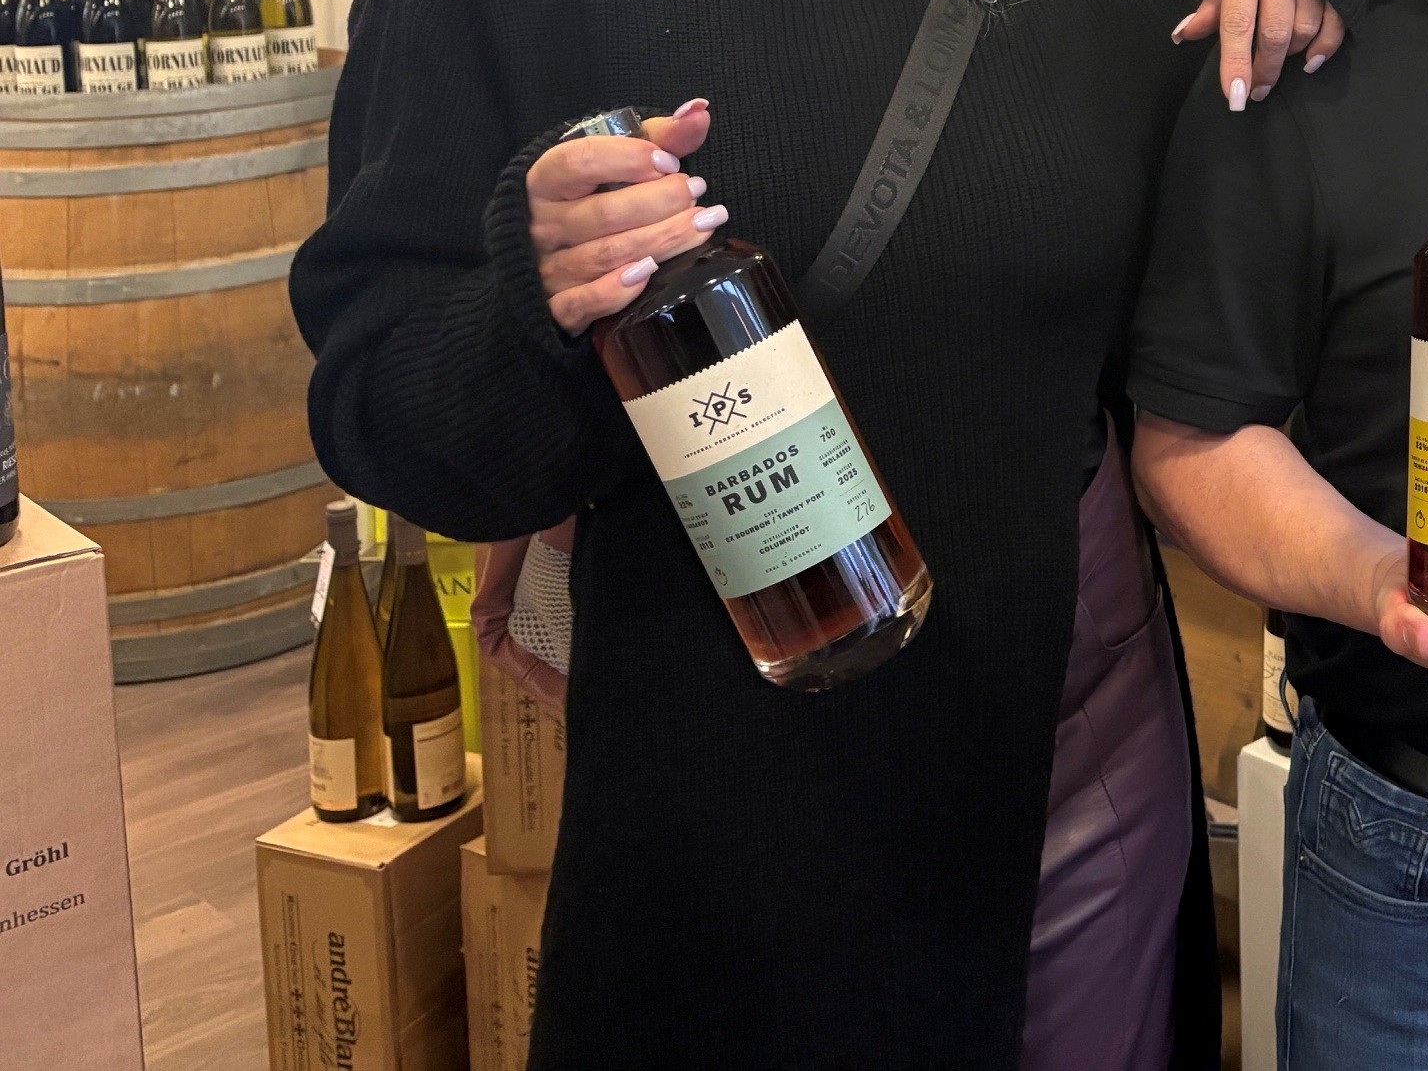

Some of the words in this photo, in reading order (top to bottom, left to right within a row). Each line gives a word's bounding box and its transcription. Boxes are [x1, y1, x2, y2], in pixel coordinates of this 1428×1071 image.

[81, 53, 134, 72] RNIAUD
[715, 428, 748, 446] PERSONAL
[751, 408, 785, 428] SELECTION
[819, 428, 836, 443] 700
[705, 444, 799, 497] BARBADOS
[822, 445, 852, 467] MOLASSES
[721, 464, 800, 516] RUM
[837, 468, 858, 485] 2025
[724, 535, 735, 543] EX
[735, 520, 771, 540] BOURBON
[777, 503, 804, 519] TAWNY
[806, 490, 826, 506] PORT
[855, 498, 875, 522] 276
[759, 525, 810, 555] COLUMN/POT
[5, 841, 69, 876] Gröhl
[0, 893, 85, 933] nhessen
